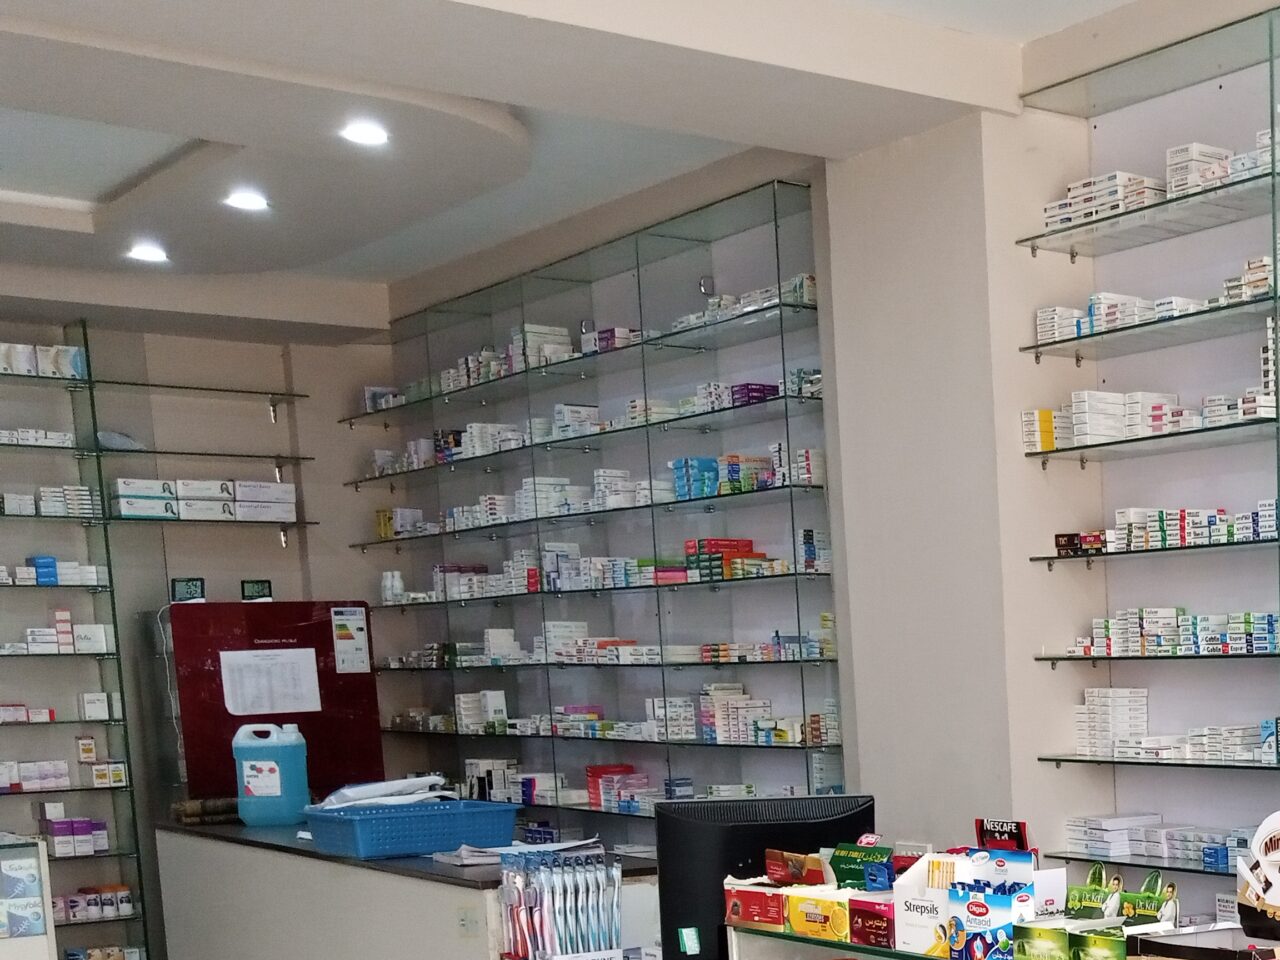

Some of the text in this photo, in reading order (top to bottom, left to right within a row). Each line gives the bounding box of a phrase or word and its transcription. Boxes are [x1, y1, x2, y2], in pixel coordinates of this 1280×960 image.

[904, 900, 939, 916] Strepsils
[968, 904, 987, 914] Digas
[966, 914, 991, 927] Antacid
